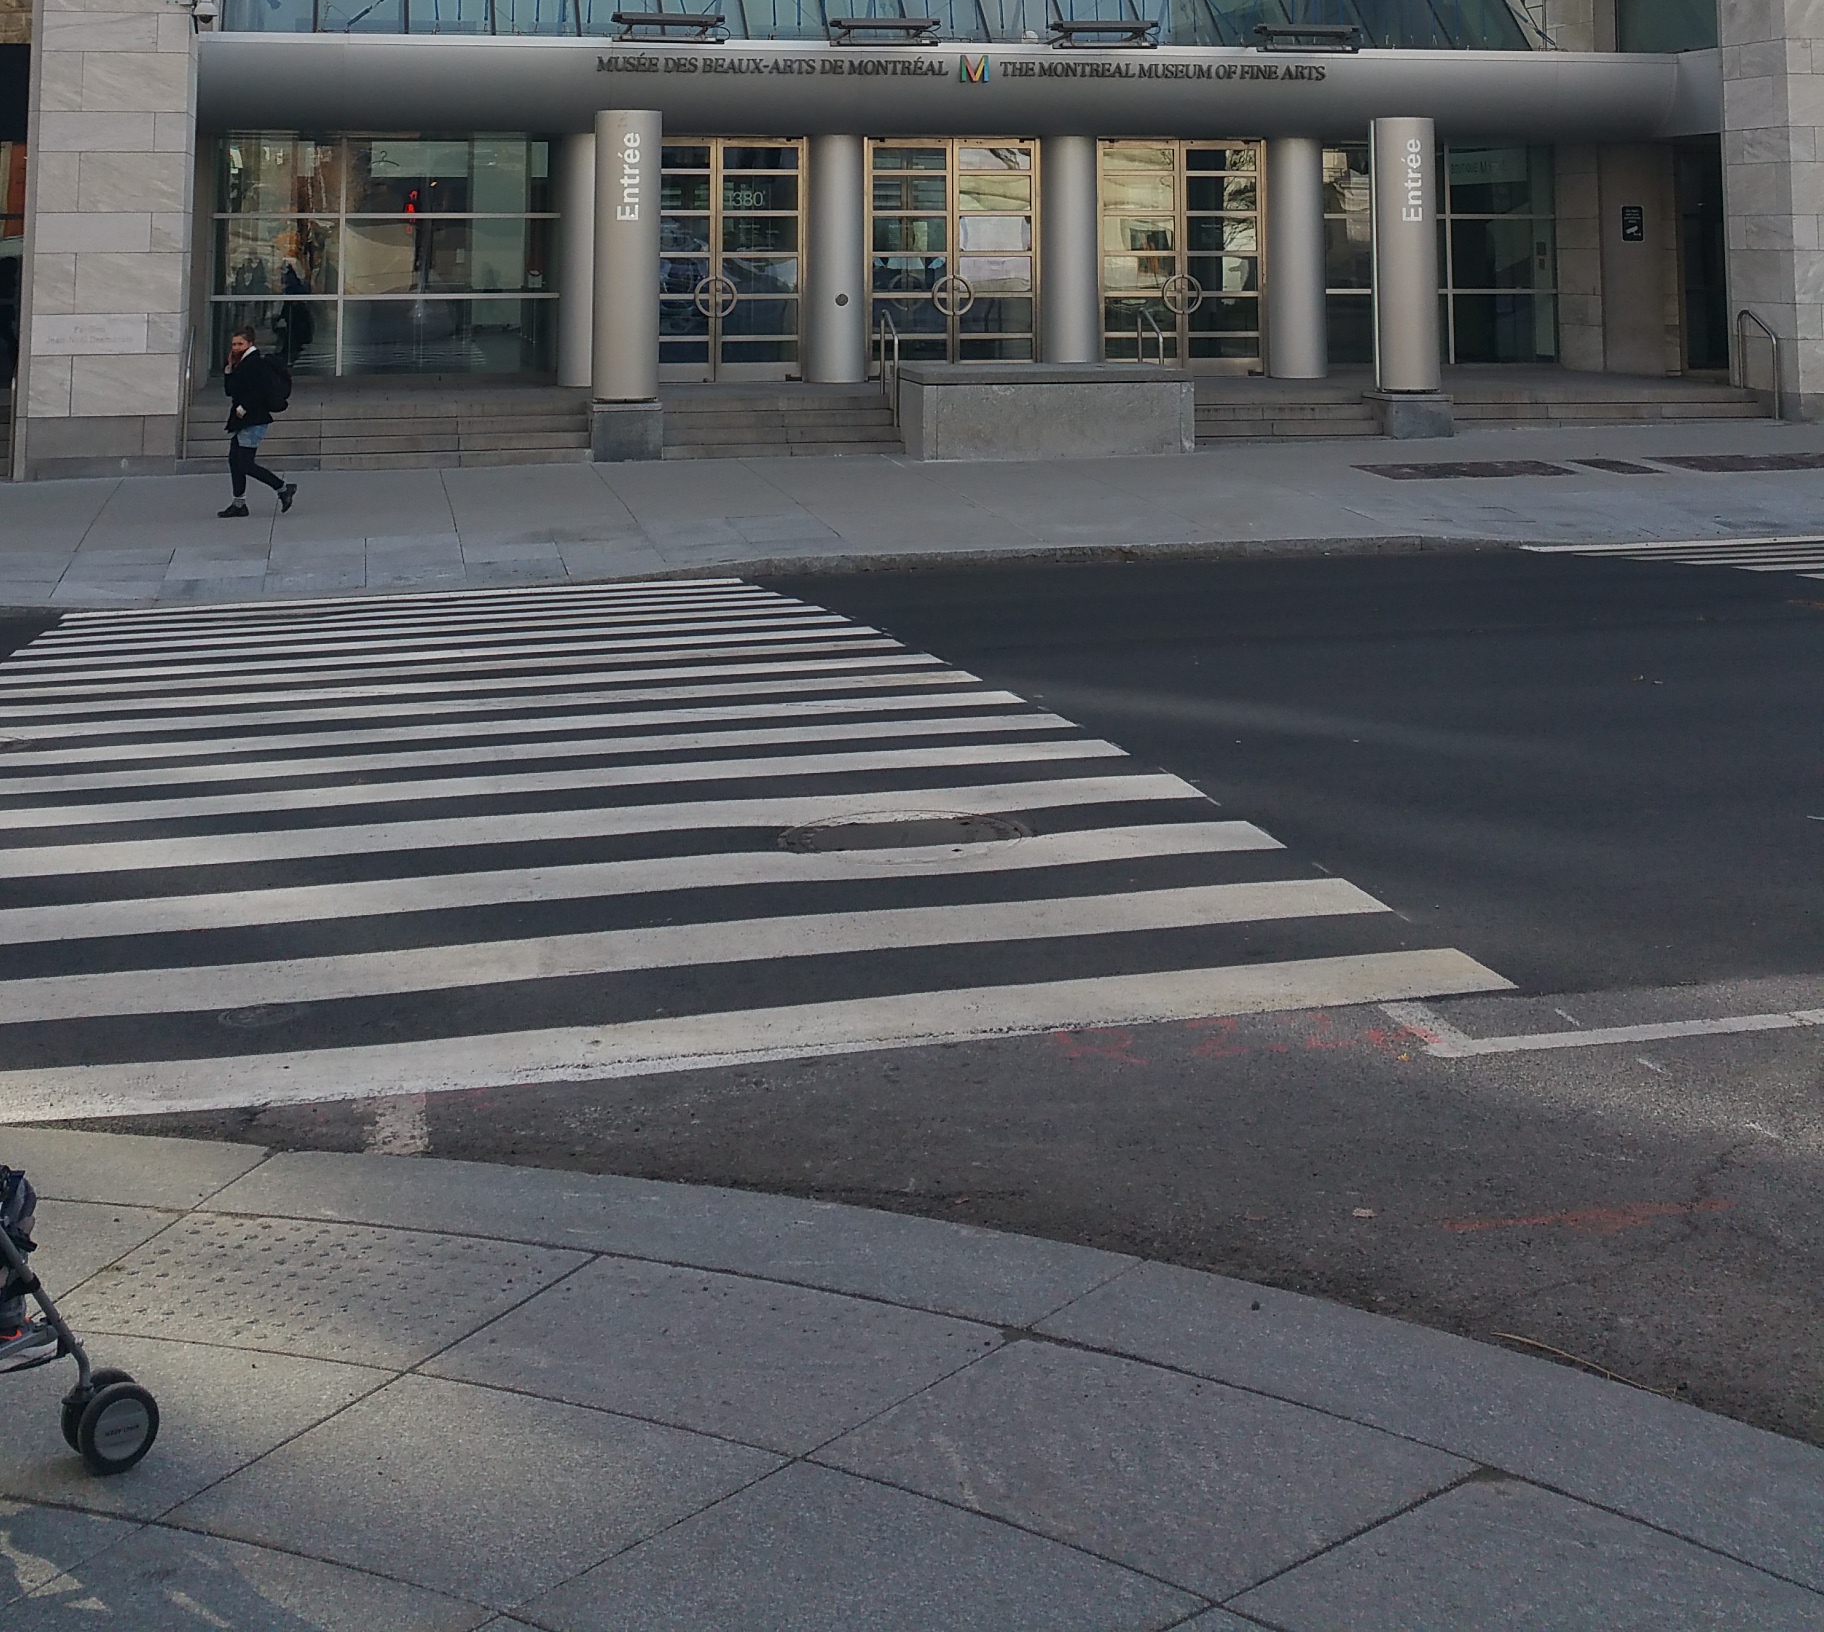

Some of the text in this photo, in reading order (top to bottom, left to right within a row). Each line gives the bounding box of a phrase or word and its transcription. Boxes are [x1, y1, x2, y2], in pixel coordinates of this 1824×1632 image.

[597, 53, 659, 73] MUSÉE
[664, 56, 698, 73] DES
[702, 57, 816, 75] BEAUX-ARTS
[820, 58, 845, 75] DE
[848, 56, 949, 76] MONTRÉAL
[1000, 61, 1326, 81] THE MONTREAL MUSEUM OF FINE ARTS
[617, 132, 641, 221] Entrée
[1402, 138, 1423, 222] Entrée
